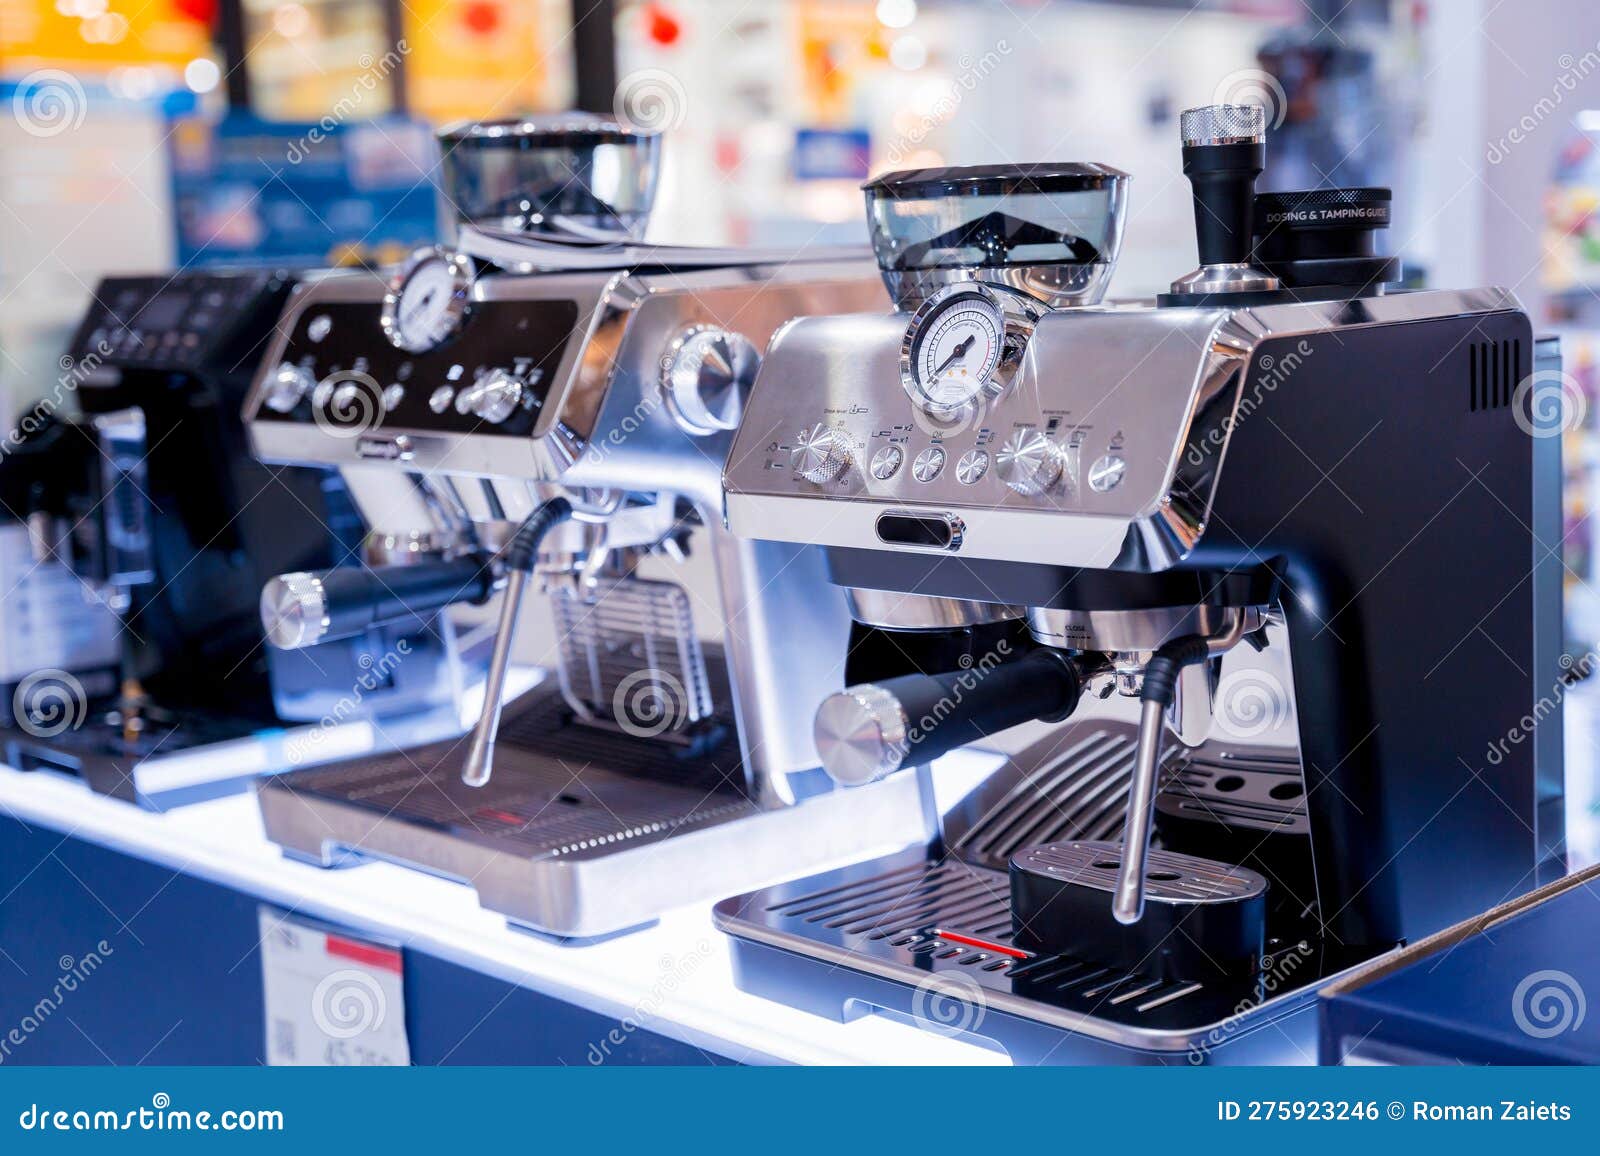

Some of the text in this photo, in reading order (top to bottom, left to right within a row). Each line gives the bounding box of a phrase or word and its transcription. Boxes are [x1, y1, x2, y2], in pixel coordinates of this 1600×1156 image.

[1266, 207, 1386, 223] DOSING & TAMPING GUIDE
[903, 424, 913, 432] x2
